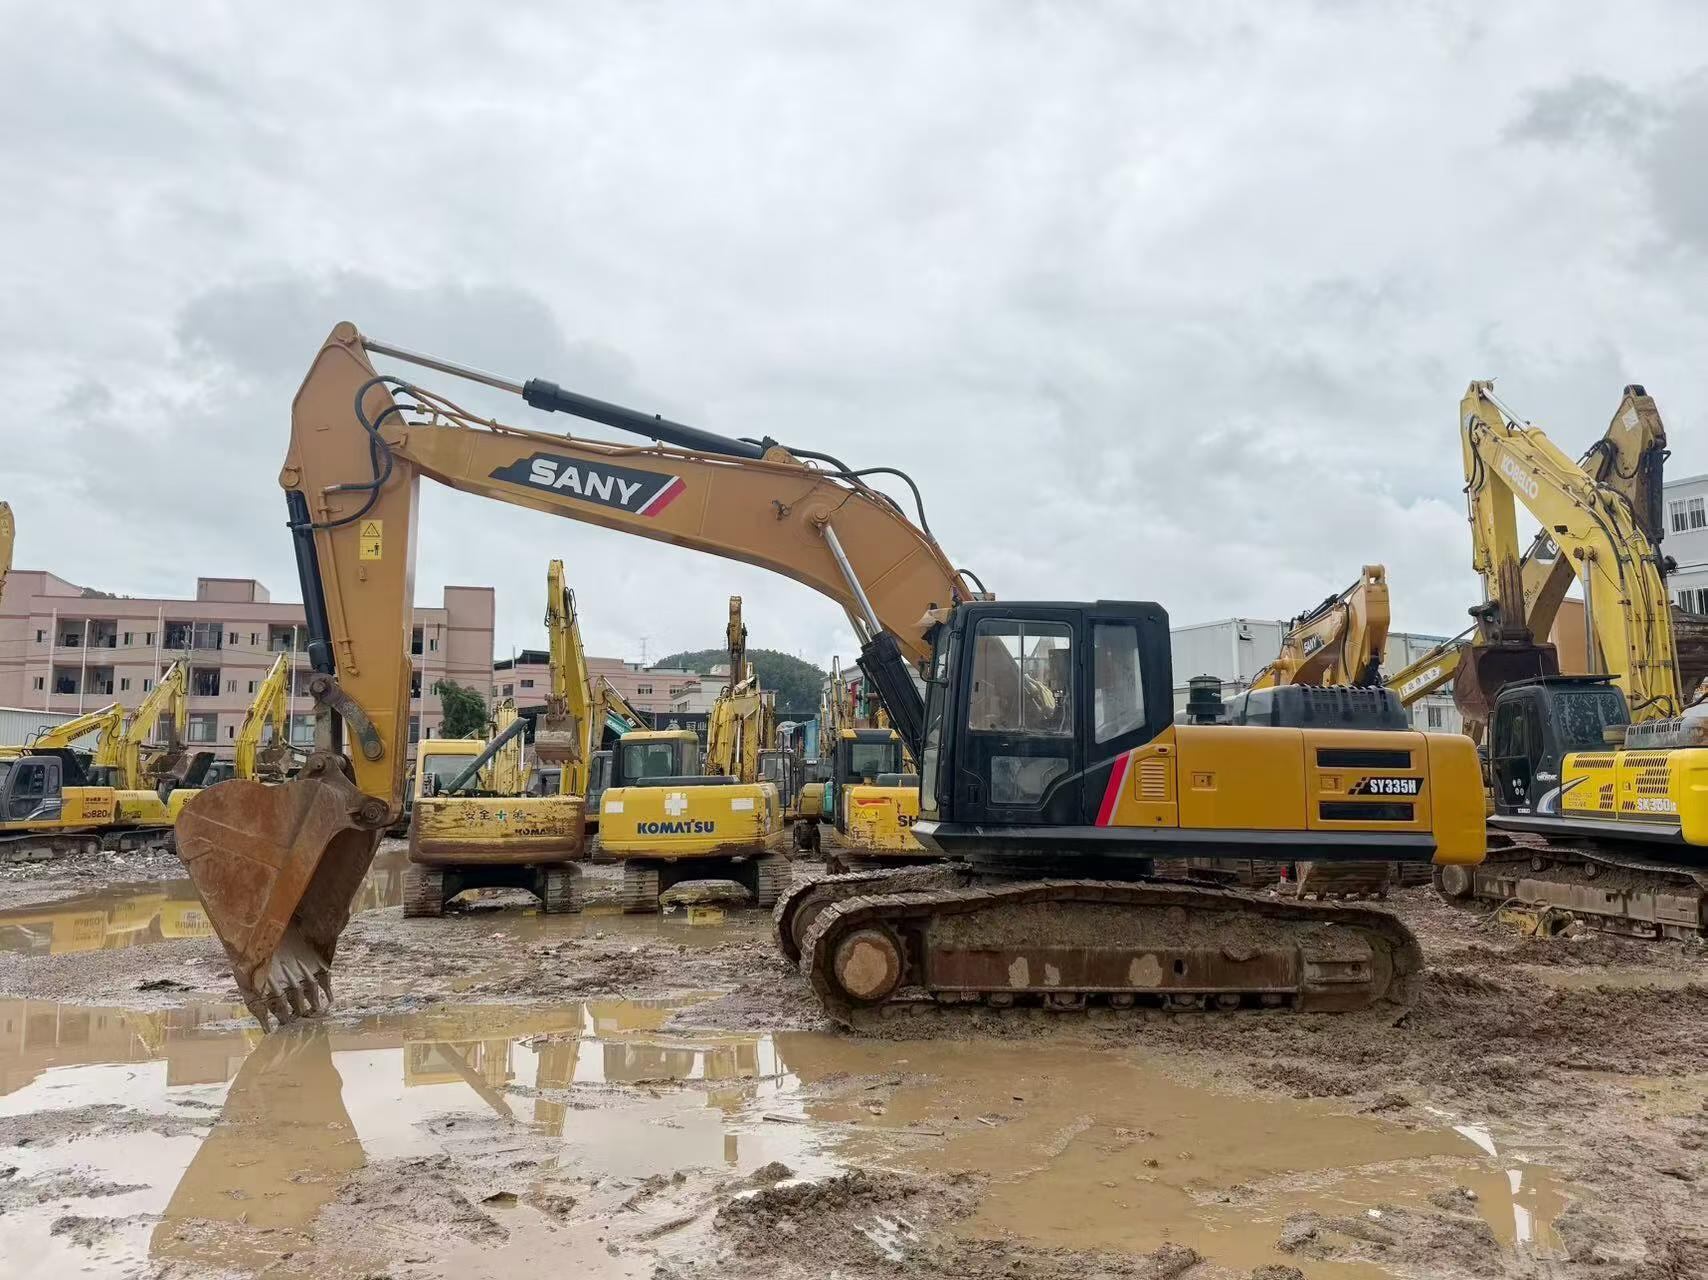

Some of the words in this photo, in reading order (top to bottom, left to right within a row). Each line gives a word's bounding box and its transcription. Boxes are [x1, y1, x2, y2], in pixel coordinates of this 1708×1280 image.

[529, 458, 642, 506] SANY
[1501, 453, 1539, 500] KOBELCO
[1370, 779, 1417, 794] SY335H
[637, 820, 715, 835] KOMATSU
